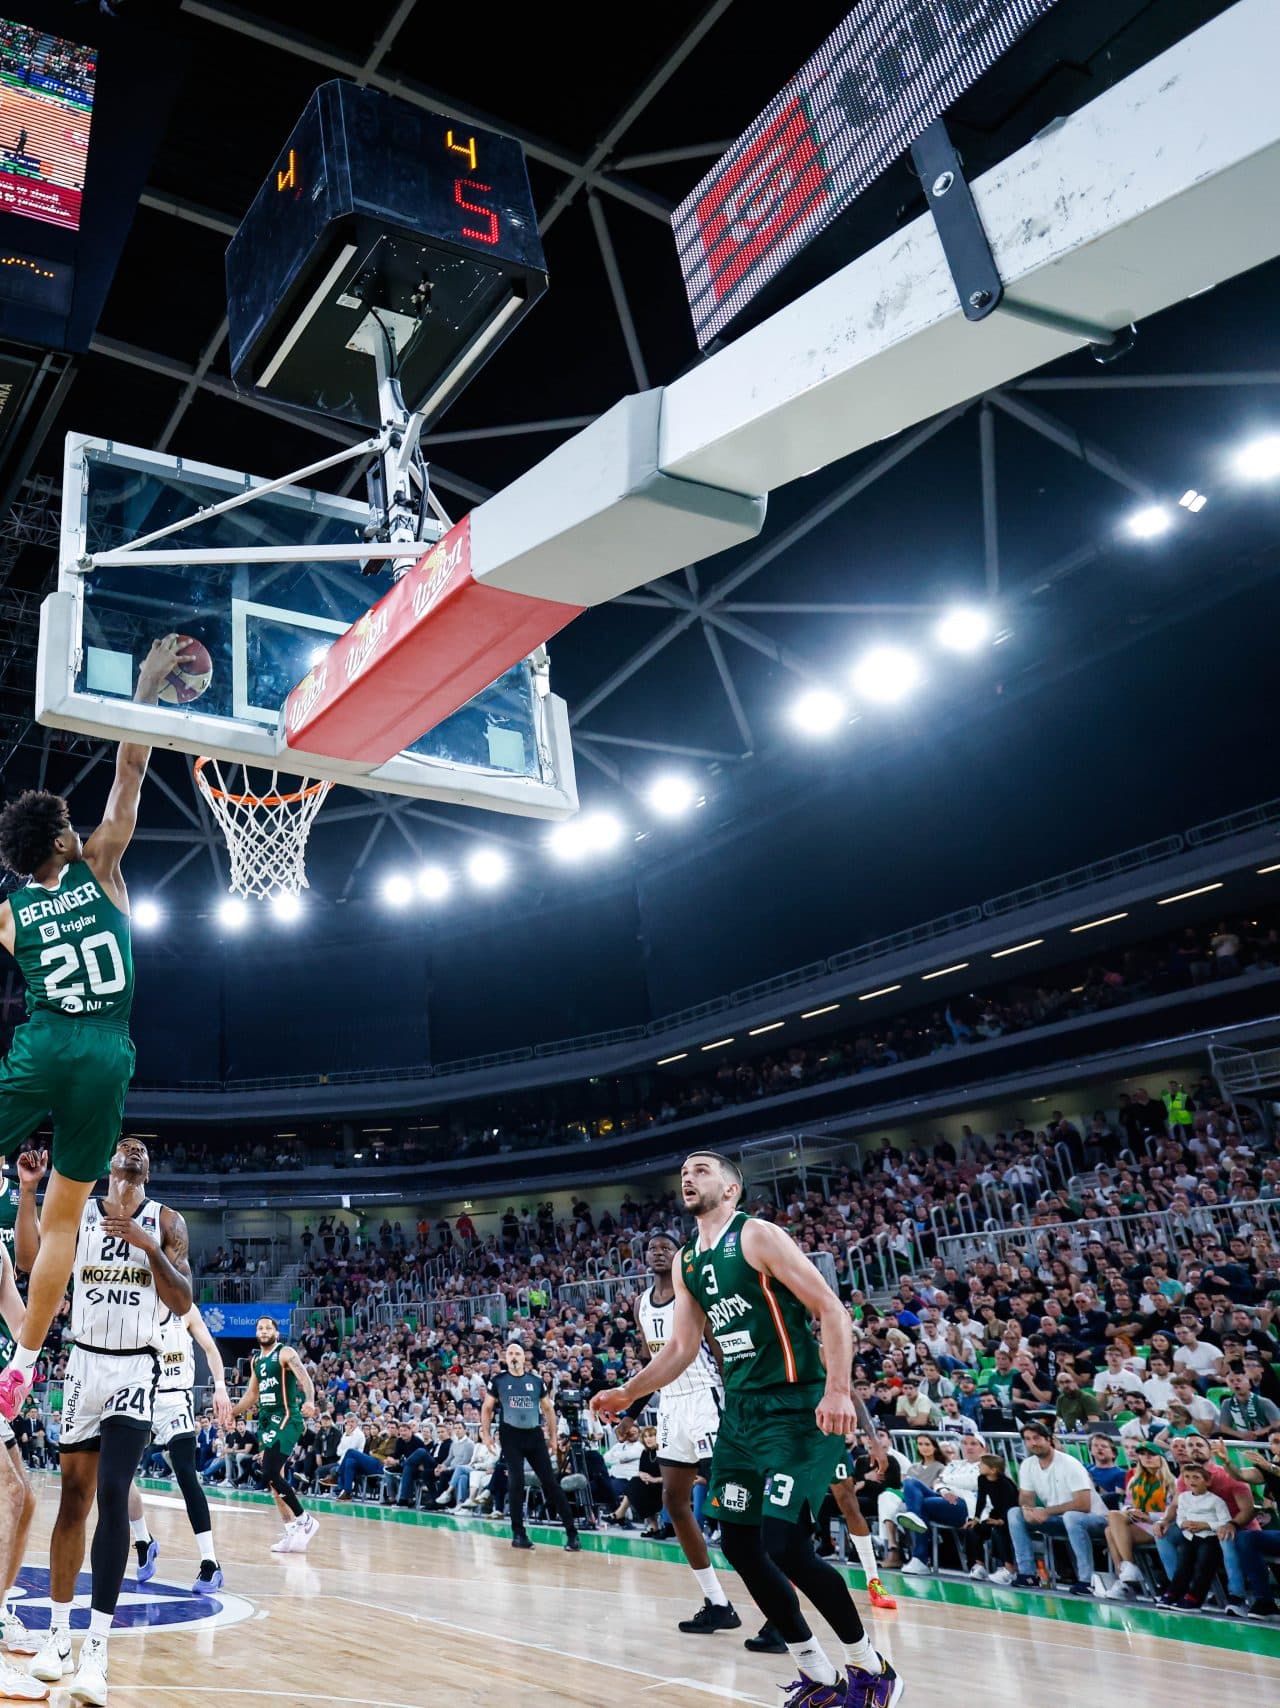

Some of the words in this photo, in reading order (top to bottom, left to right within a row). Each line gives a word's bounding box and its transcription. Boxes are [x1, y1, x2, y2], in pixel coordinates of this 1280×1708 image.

[447, 130, 477, 169] 4
[454, 179, 499, 244] 5
[18, 881, 101, 928] BERINGER
[61, 914, 96, 933] triglav
[40, 930, 126, 1000] 20
[101, 1235, 130, 1261] 24
[82, 1269, 149, 1285] MOZZART
[702, 1264, 718, 1295] 3
[107, 1289, 141, 1306] NIS
[228, 1316, 258, 1326] Teleko
[706, 1293, 752, 1332] DEVITA
[652, 1318, 664, 1338] 17
[721, 1338, 746, 1348] ETROL
[260, 1363, 267, 1377] 2
[66, 1379, 82, 1424] AikBank
[114, 1387, 145, 1414] 24
[179, 1413, 188, 1429] 7
[835, 1463, 847, 1480] 0
[770, 1473, 794, 1507] 3
